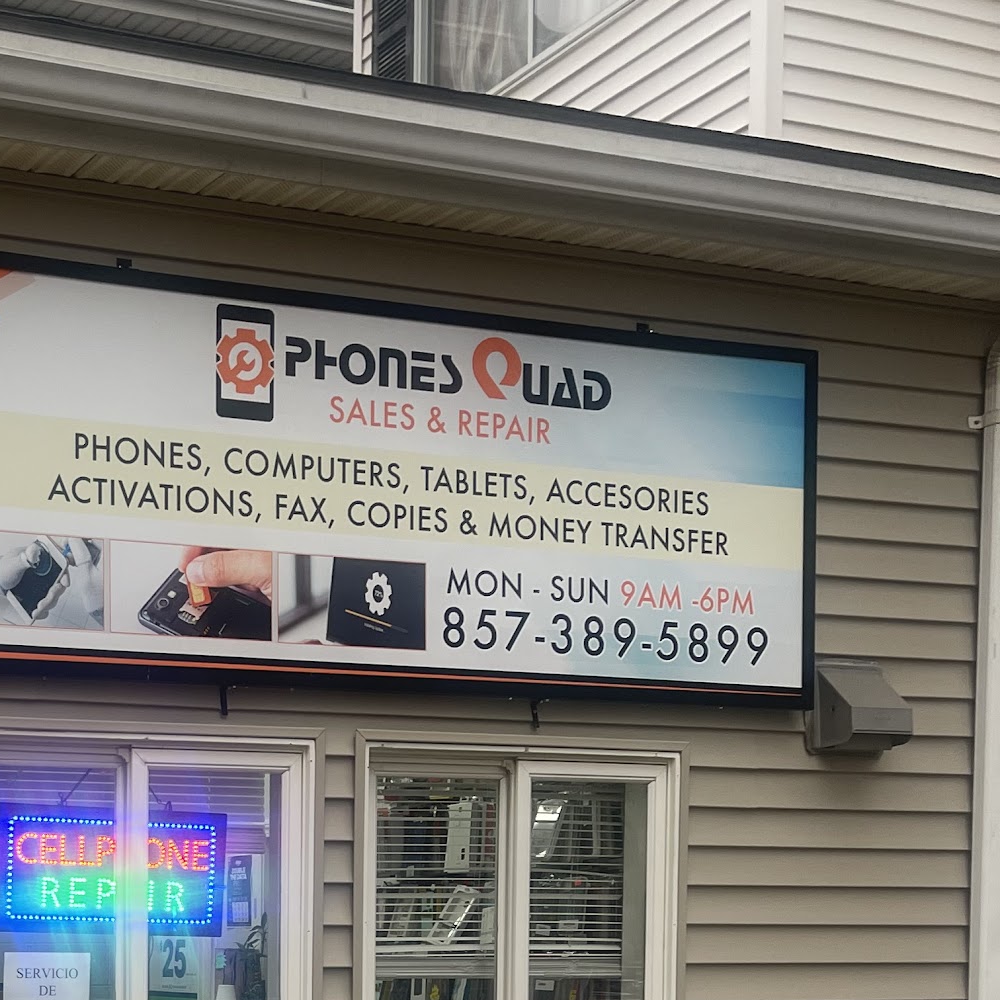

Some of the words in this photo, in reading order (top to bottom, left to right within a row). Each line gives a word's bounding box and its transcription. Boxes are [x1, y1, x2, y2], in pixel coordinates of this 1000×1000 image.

[285, 335, 463, 395] PHONES
[329, 395, 415, 432] SALES
[427, 408, 447, 434] &
[458, 410, 551, 445] REPAIR
[74, 432, 211, 477] PHONES,
[224, 447, 409, 495] COMPUTERS,
[420, 465, 535, 505] TABLETS,
[546, 478, 709, 517] ACCESORIES
[47, 474, 262, 524] ACTIVATIONS,
[275, 494, 335, 529] FAX,
[347, 500, 448, 533] COPIES
[459, 509, 478, 536] &
[489, 512, 592, 545] MONEY
[600, 521, 729, 556] TRANSFER
[446, 567, 523, 600] MON
[550, 575, 609, 606] SUN
[620, 580, 681, 610] 9AM
[442, 606, 769, 667] 857-389-5899
[15, 831, 210, 871] CELLPONE
[40, 876, 185, 912] REPIR
[16, 968, 78, 980] SERVICIO
[39, 985, 56, 997] DE
